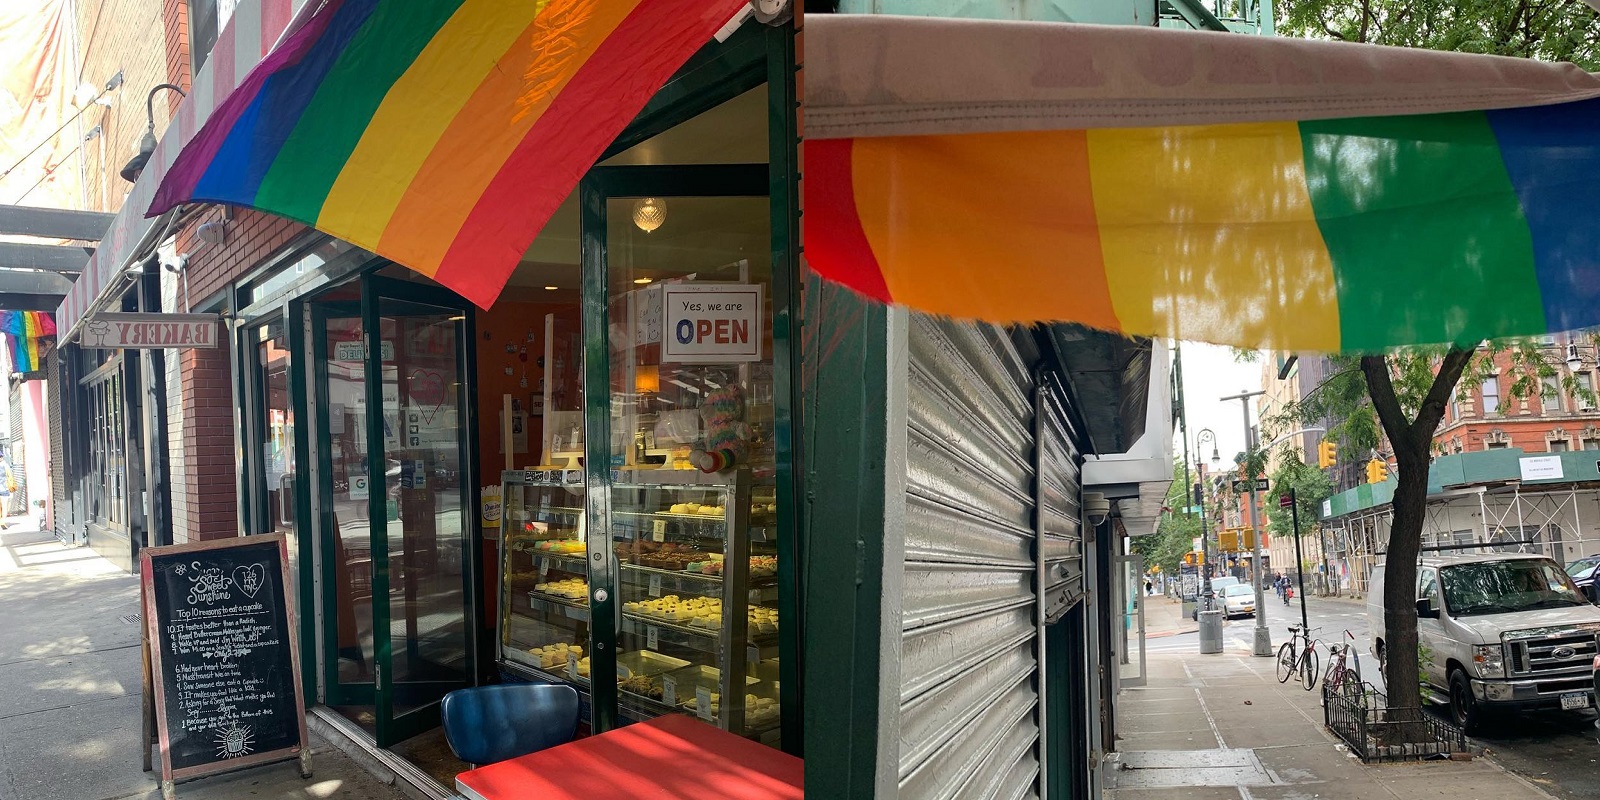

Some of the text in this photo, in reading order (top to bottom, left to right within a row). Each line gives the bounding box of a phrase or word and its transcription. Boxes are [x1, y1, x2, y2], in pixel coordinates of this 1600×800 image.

[682, 301, 742, 313] Yes, we are
[676, 319, 749, 345] OPEN
[242, 569, 257, 580] 126
[187, 586, 231, 605] Sunshine
[176, 609, 191, 622] Top
[192, 608, 198, 616] 10
[199, 608, 221, 616] reasons
[222, 606, 228, 614] to
[228, 604, 238, 613] eat
[204, 622, 221, 630] better
[204, 662, 218, 670] heart
